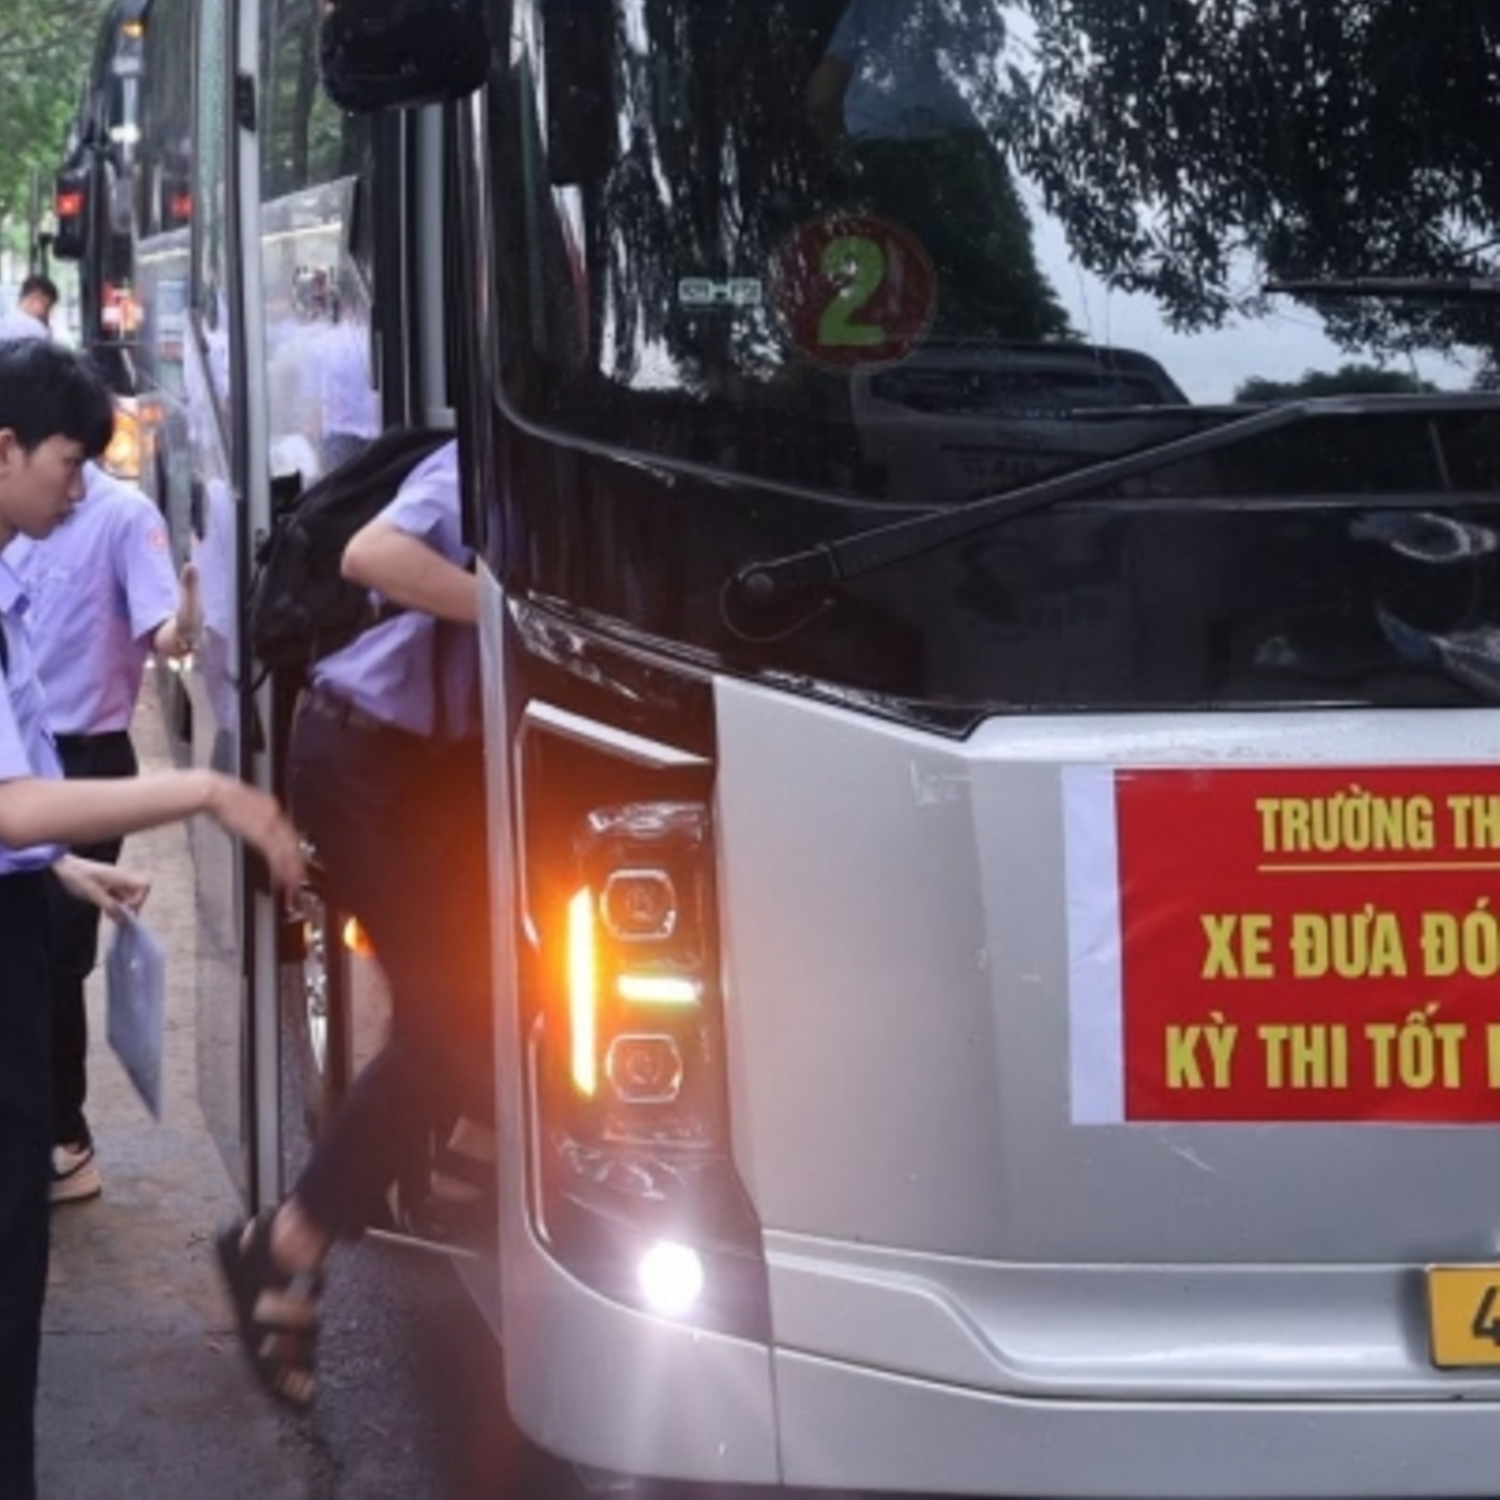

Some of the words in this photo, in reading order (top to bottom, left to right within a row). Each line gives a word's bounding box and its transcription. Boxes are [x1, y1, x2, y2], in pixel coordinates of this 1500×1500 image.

[817, 236, 888, 346] 2
[1256, 783, 1435, 851] TRƯỜNG
[1447, 795, 1500, 849] TH
[1201, 913, 1275, 979] XE
[1290, 903, 1408, 978] ĐƯA
[1421, 896, 1500, 977] ĐÓ
[1166, 1011, 1239, 1089] KỲ
[1258, 1023, 1348, 1089] THI
[1365, 1002, 1467, 1089] TỐT
